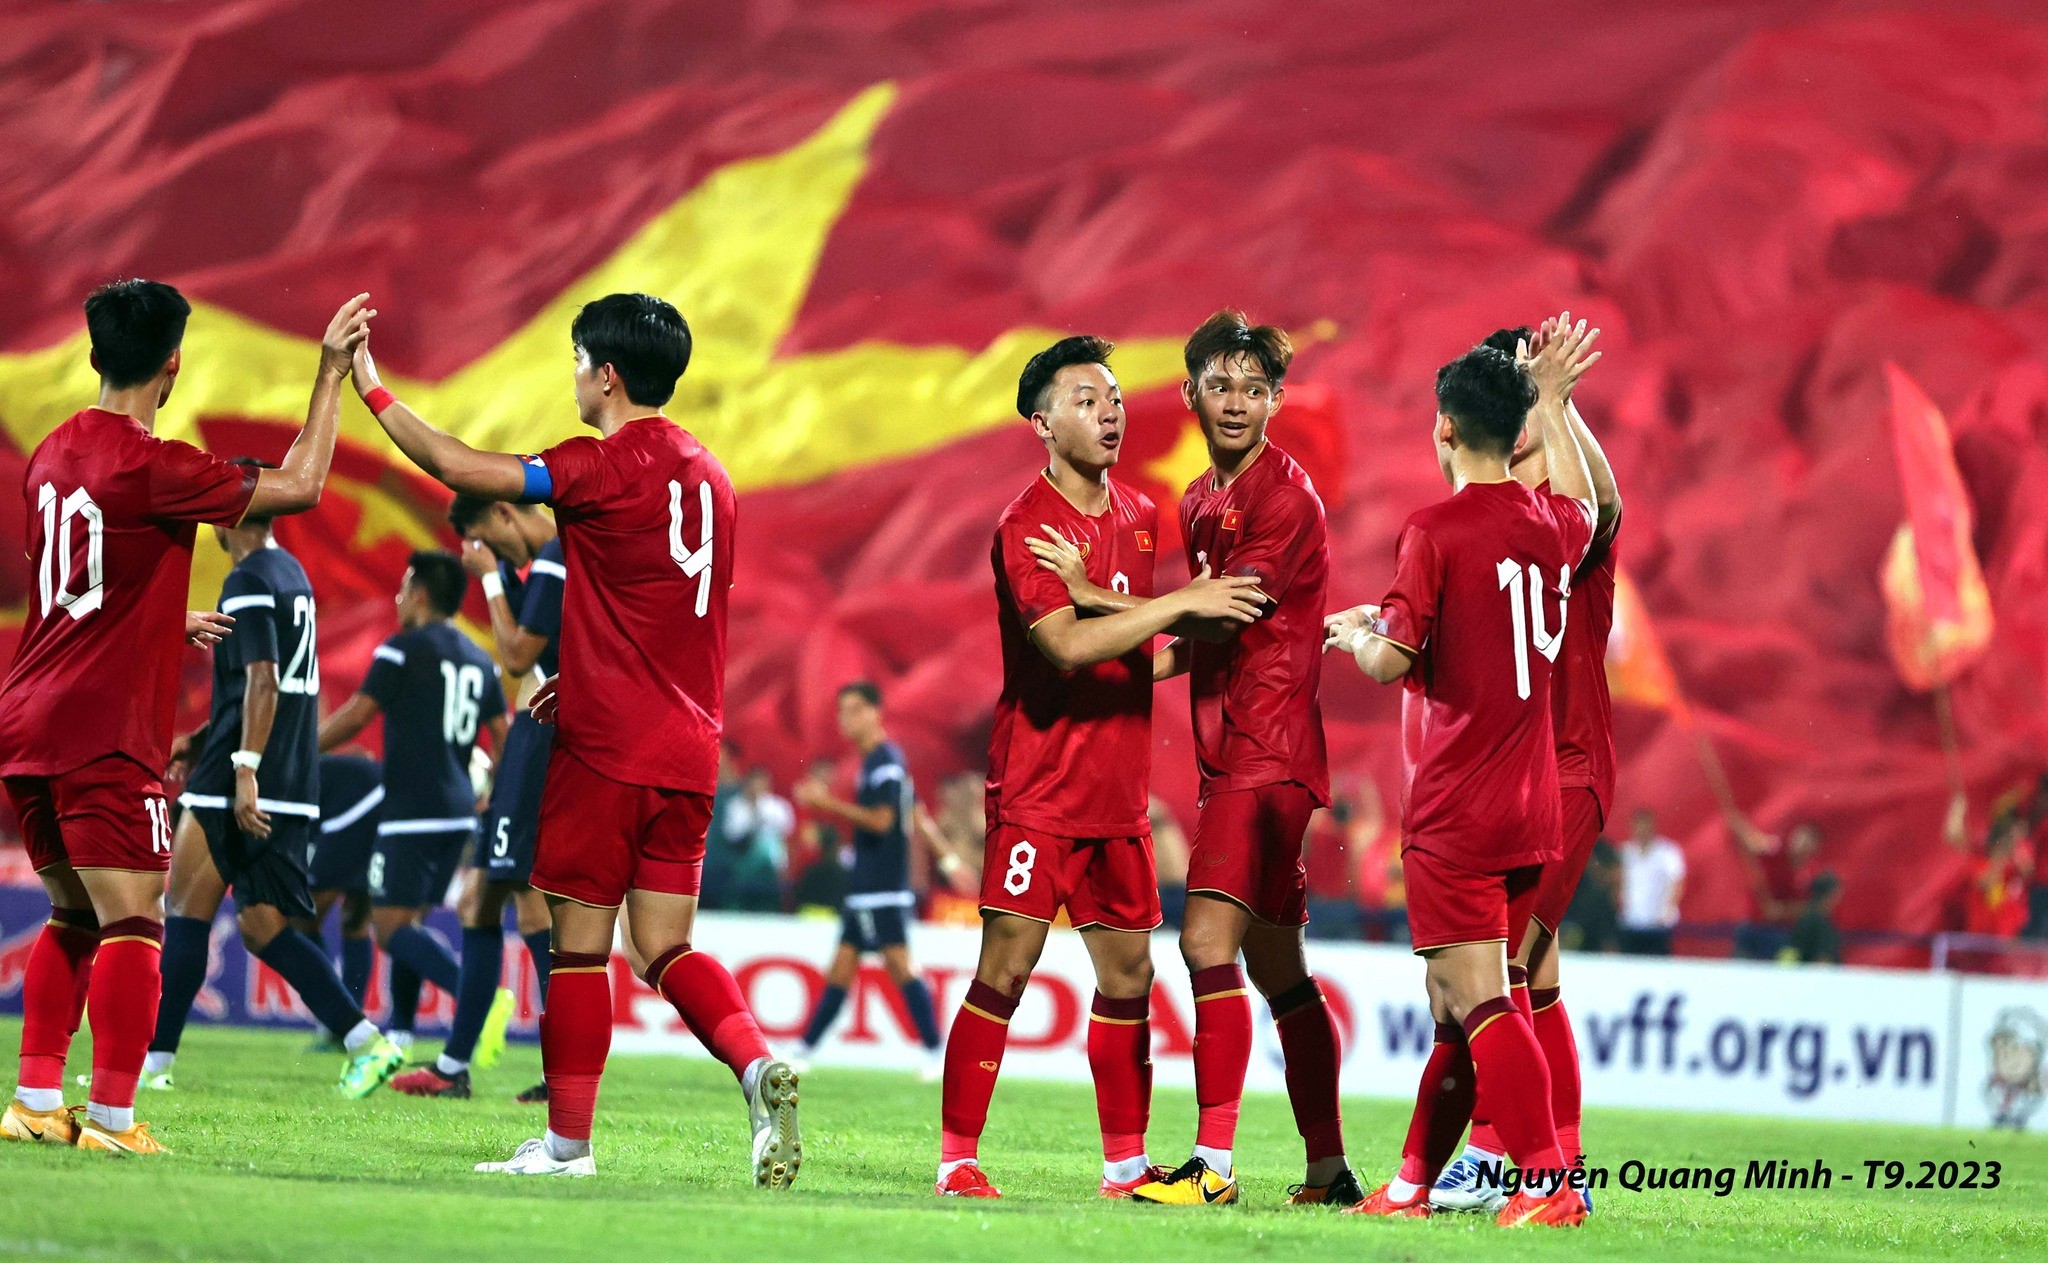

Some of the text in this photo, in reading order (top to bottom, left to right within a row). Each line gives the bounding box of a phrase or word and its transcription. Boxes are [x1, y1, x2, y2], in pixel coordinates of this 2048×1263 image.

[38, 481, 104, 620] 10
[668, 479, 713, 618] 4
[1496, 557, 1571, 701] 14
[440, 660, 484, 745] 16
[494, 816, 511, 857] 5
[1003, 840, 1037, 896] 8
